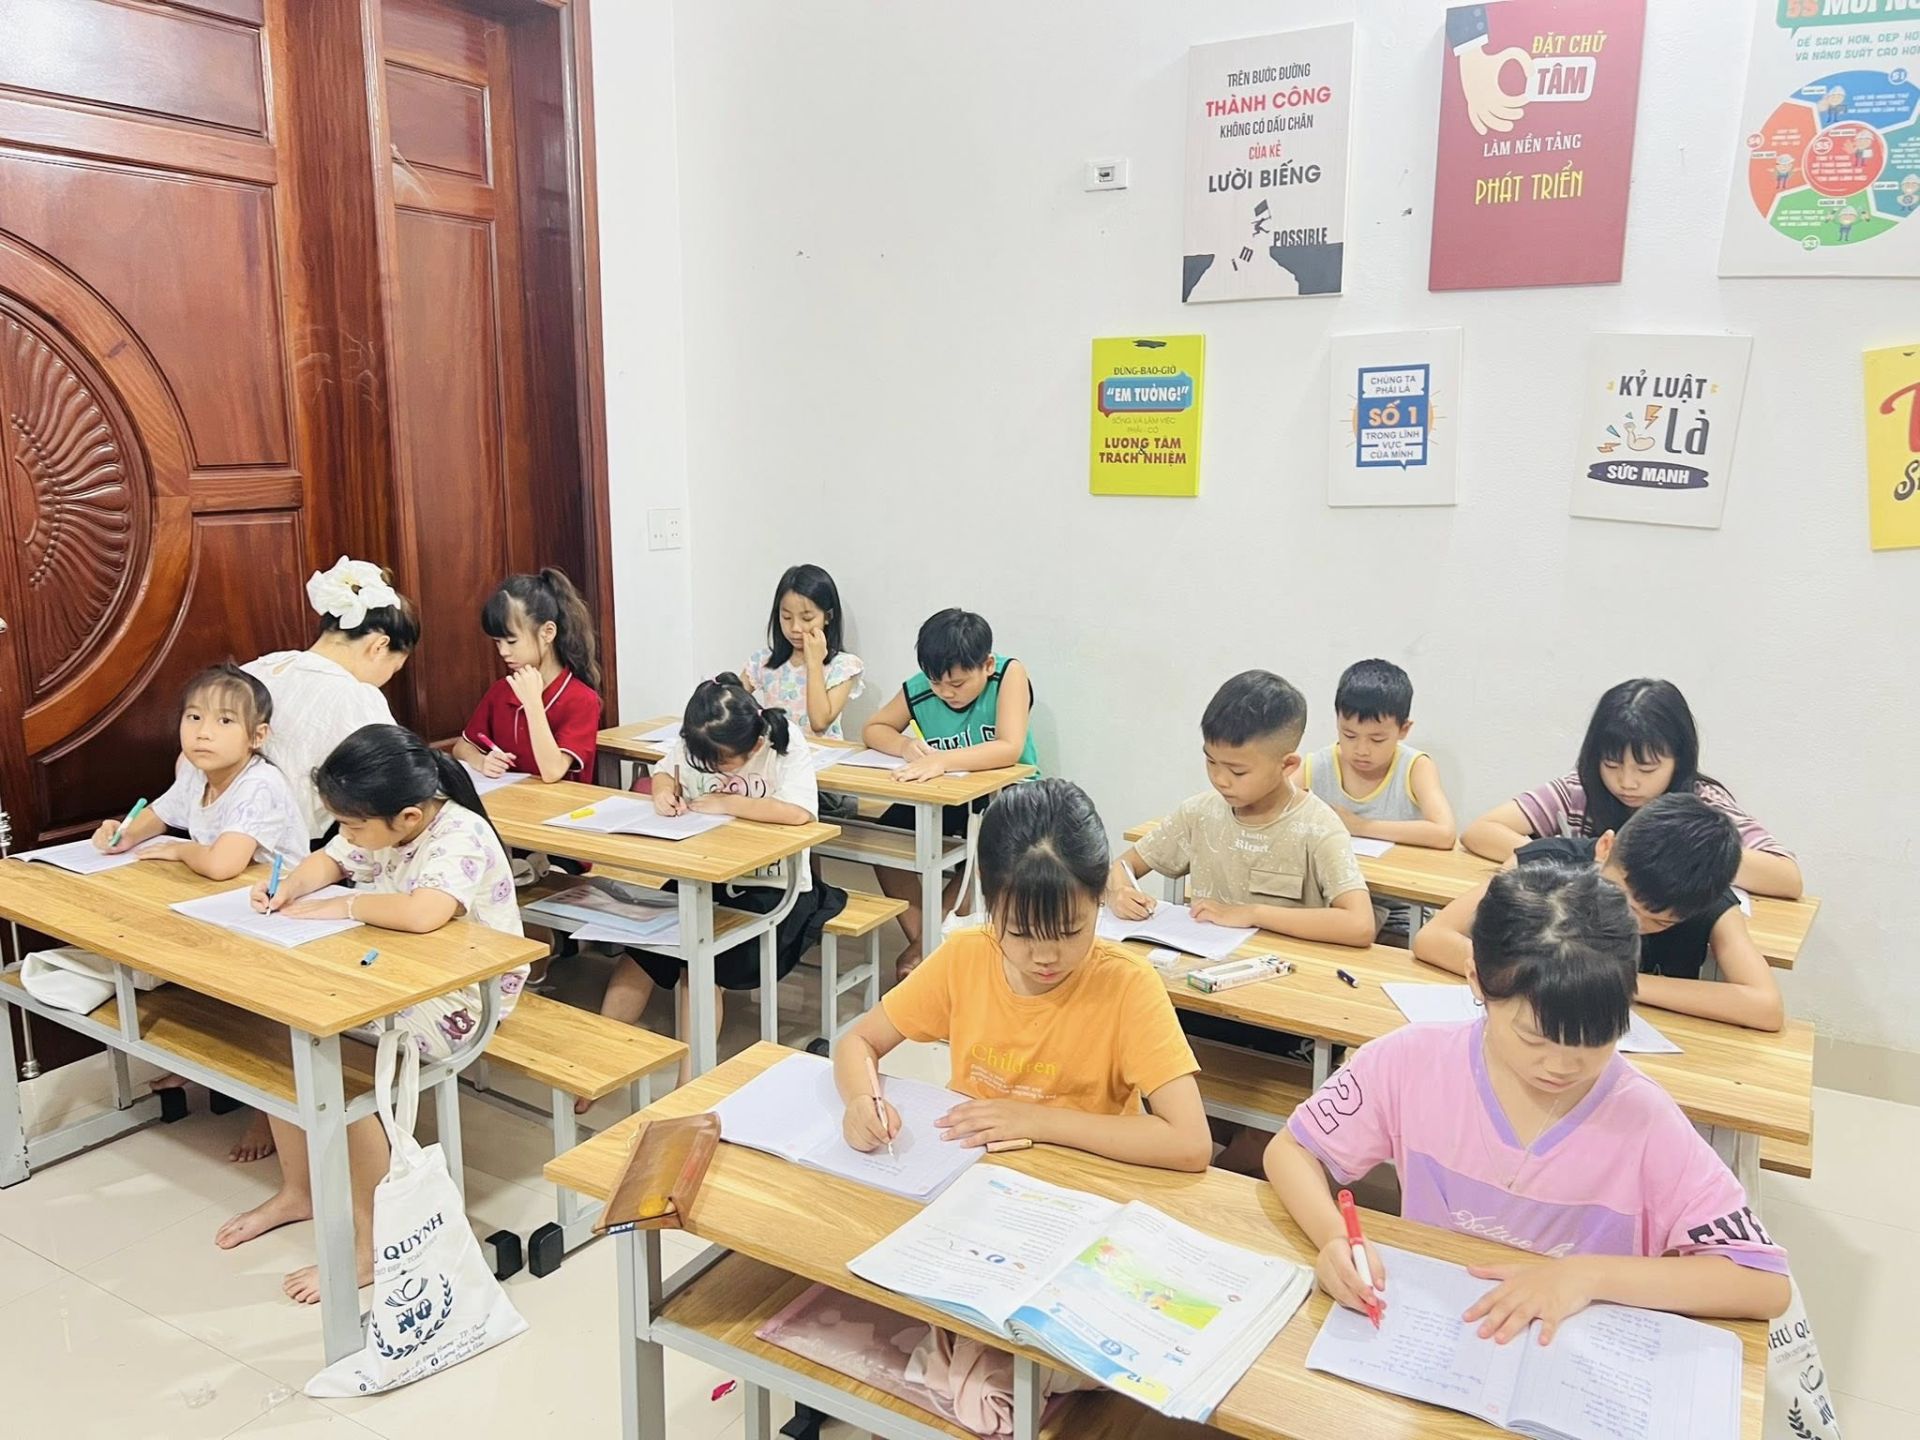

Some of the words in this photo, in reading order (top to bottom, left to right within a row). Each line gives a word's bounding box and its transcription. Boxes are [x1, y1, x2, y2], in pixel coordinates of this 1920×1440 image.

[1532, 32, 1566, 58] ĐẶT
[1569, 30, 1607, 54] CHỮ
[1228, 70, 1250, 88] TRÊN
[1537, 63, 1587, 95] TÂM
[1206, 95, 1266, 117] THÀNH
[1272, 86, 1332, 109] CÔNG
[1220, 119, 1251, 139] KHÔNG
[1253, 117, 1266, 135] CÓ
[1267, 114, 1286, 133] DẤU
[1288, 113, 1314, 131] CHÂN
[1249, 142, 1267, 160] CỦA
[1484, 138, 1511, 157] LÀM
[1515, 132, 1542, 153] NỀN
[1545, 131, 1582, 151] TẢNG
[1209, 168, 1252, 192] LƯỜI
[1259, 159, 1321, 187] BIẾNG
[1475, 171, 1524, 205] PHÁT
[1531, 160, 1584, 201] TRIỂN
[1273, 227, 1328, 247] POSSIBLE
[1405, 375, 1416, 383] TA
[1619, 369, 1647, 396] KỶ
[1653, 374, 1707, 403] LUẬT
[1369, 400, 1400, 426] SỐ
[1408, 406, 1417, 425] 1
[1366, 431, 1397, 440] TRONG
[1607, 463, 1638, 479] SỨC
[1642, 467, 1690, 485] MẠNH
[383, 1212, 444, 1261] QUỲNH
